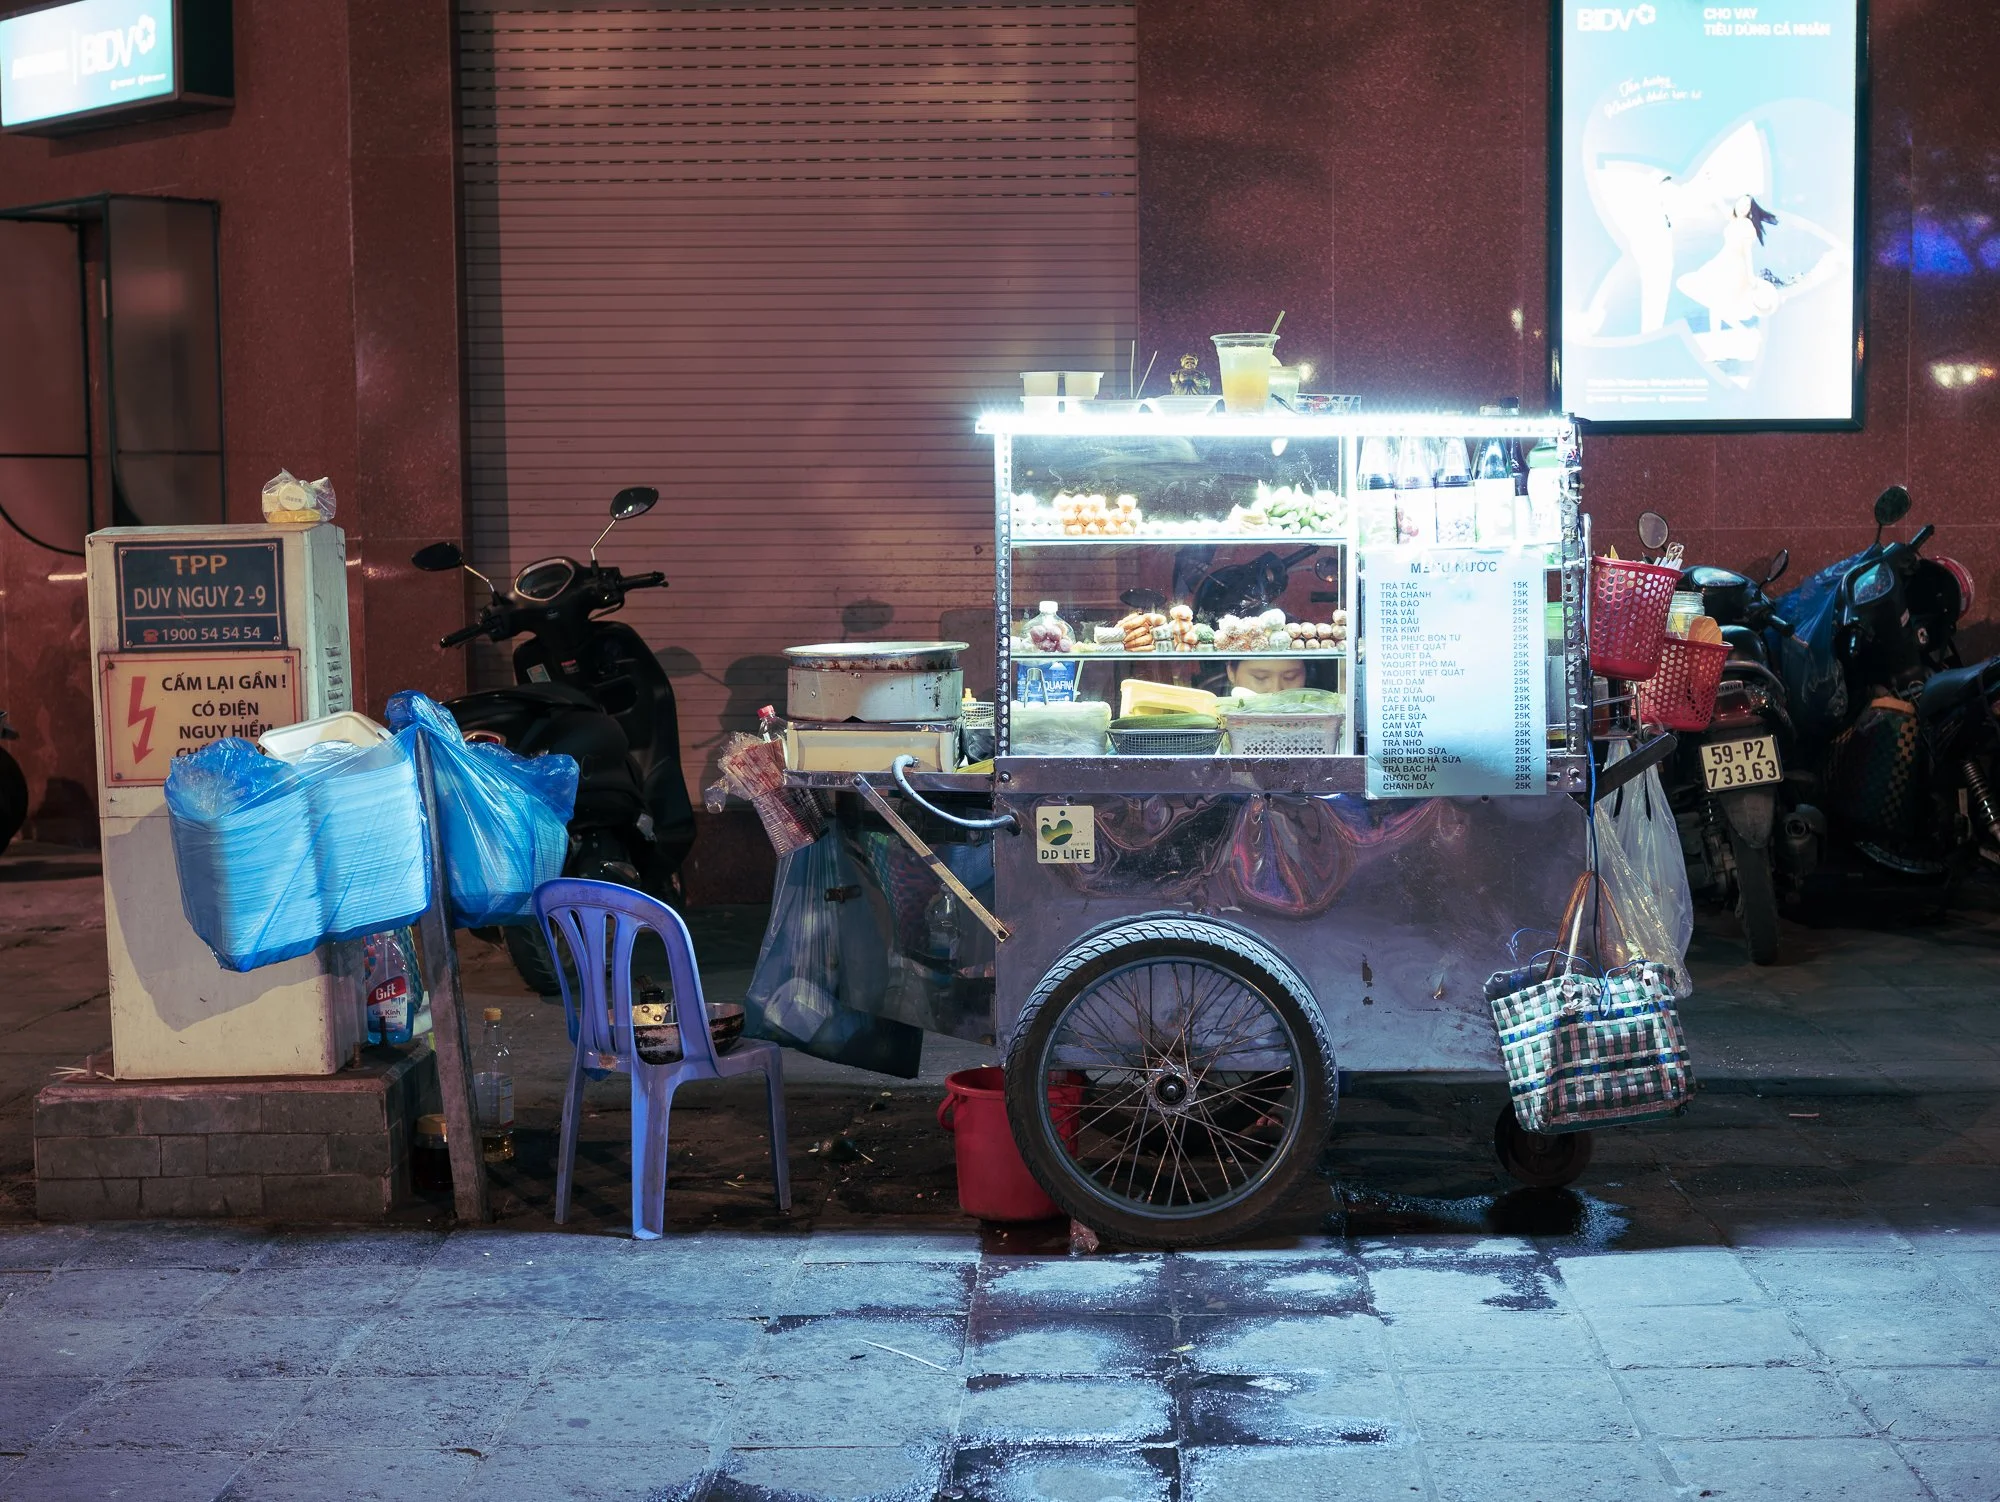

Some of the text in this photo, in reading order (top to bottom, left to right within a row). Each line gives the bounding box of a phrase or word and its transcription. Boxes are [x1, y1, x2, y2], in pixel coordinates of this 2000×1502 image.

[1703, 7, 1758, 20] CHO VAY
[169, 554, 228, 576] TPP
[134, 588, 172, 610] DUY
[178, 586, 229, 608] NGUY
[162, 626, 261, 642] 1900 54 54 54
[162, 672, 202, 691] CẤM
[207, 675, 234, 694] LẠI
[192, 699, 259, 719] CÓ ĐIỆN
[180, 725, 227, 739] NGUY
[1406, 757, 1425, 765] BẠC
[1711, 740, 1766, 765] 59-P2
[1383, 764, 1400, 772] TRÀ
[1403, 766, 1422, 774] BẠC
[1708, 760, 1777, 788] 733.63
[1416, 781, 1434, 789] DÂY
[1041, 849, 1091, 859] DD LIFE
[375, 983, 396, 1001] Gift
